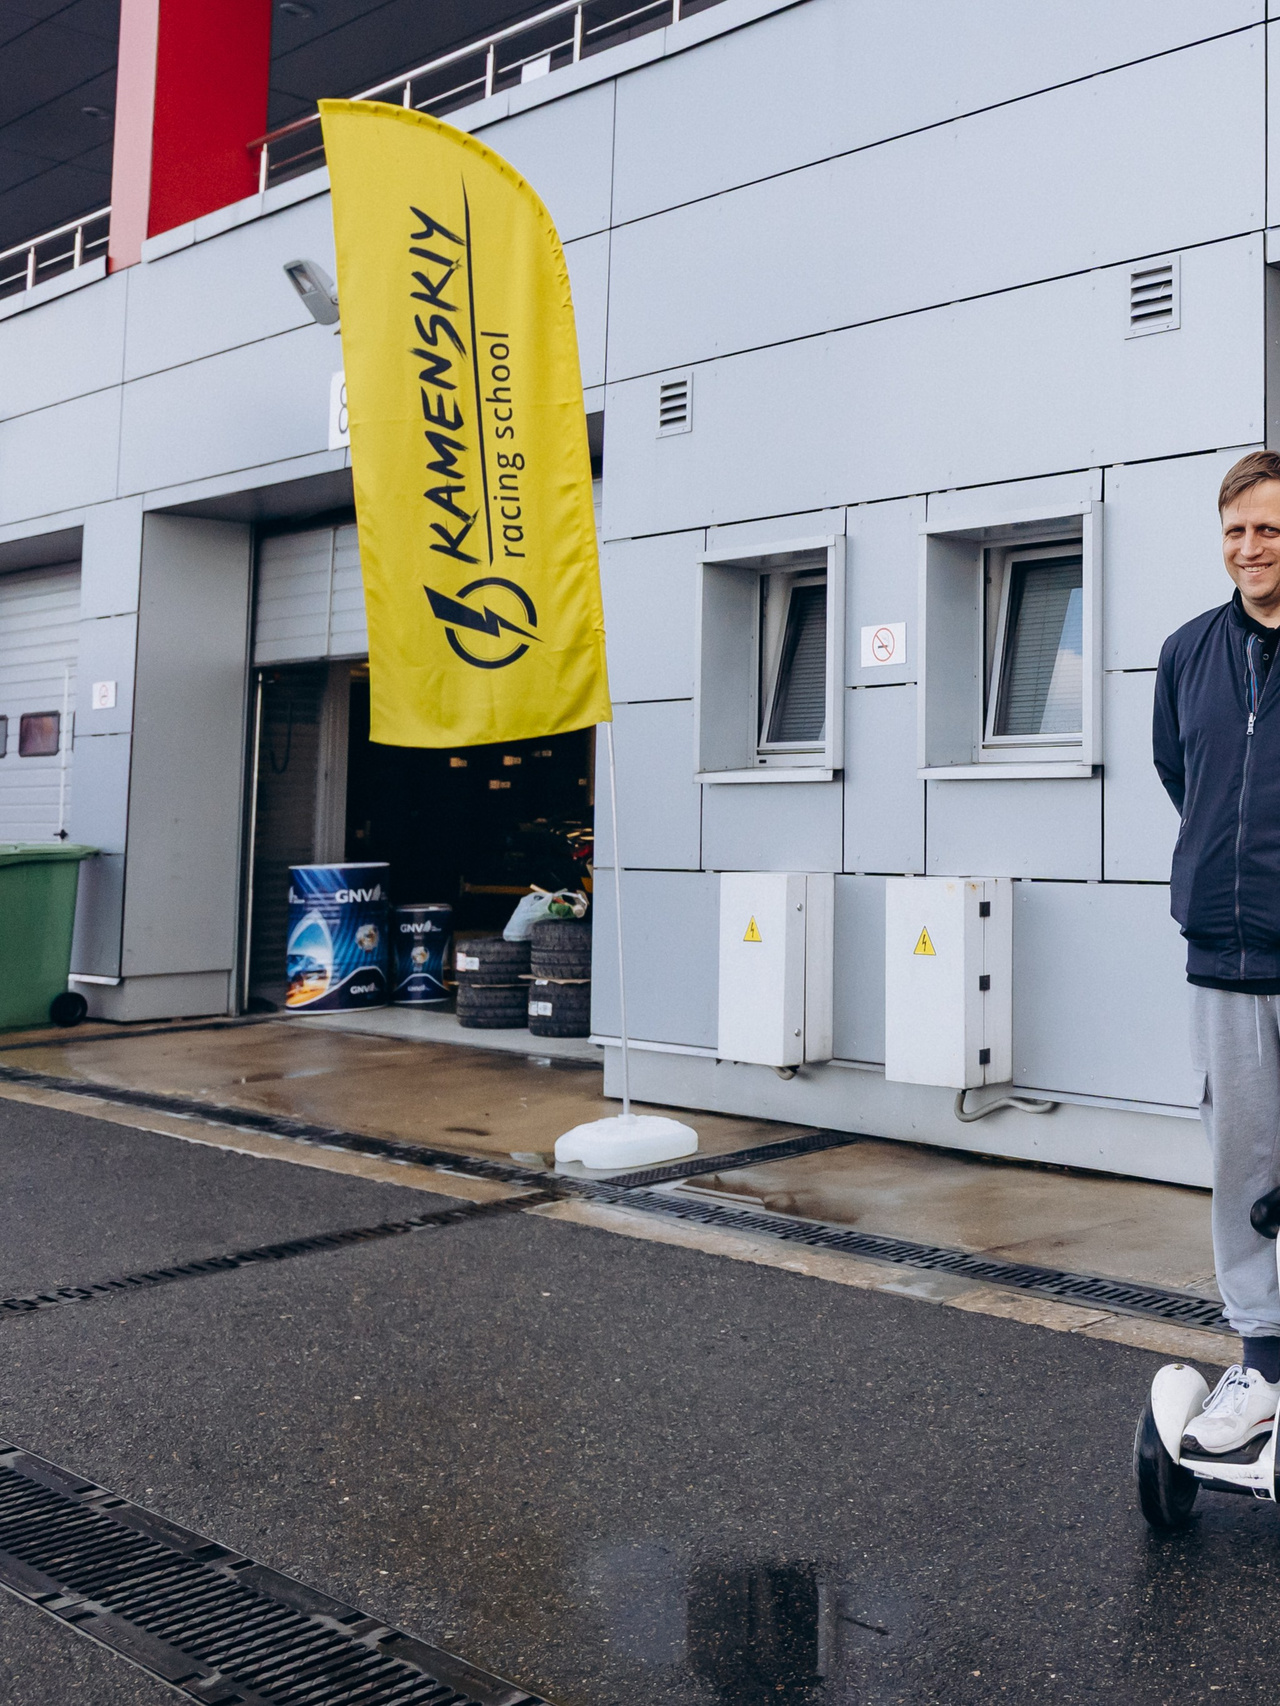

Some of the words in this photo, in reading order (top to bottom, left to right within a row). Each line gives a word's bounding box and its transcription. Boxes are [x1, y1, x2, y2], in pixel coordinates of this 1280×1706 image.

[408, 205, 482, 566] KAMENSKIY
[481, 331, 515, 440] school
[493, 451, 526, 558] racing
